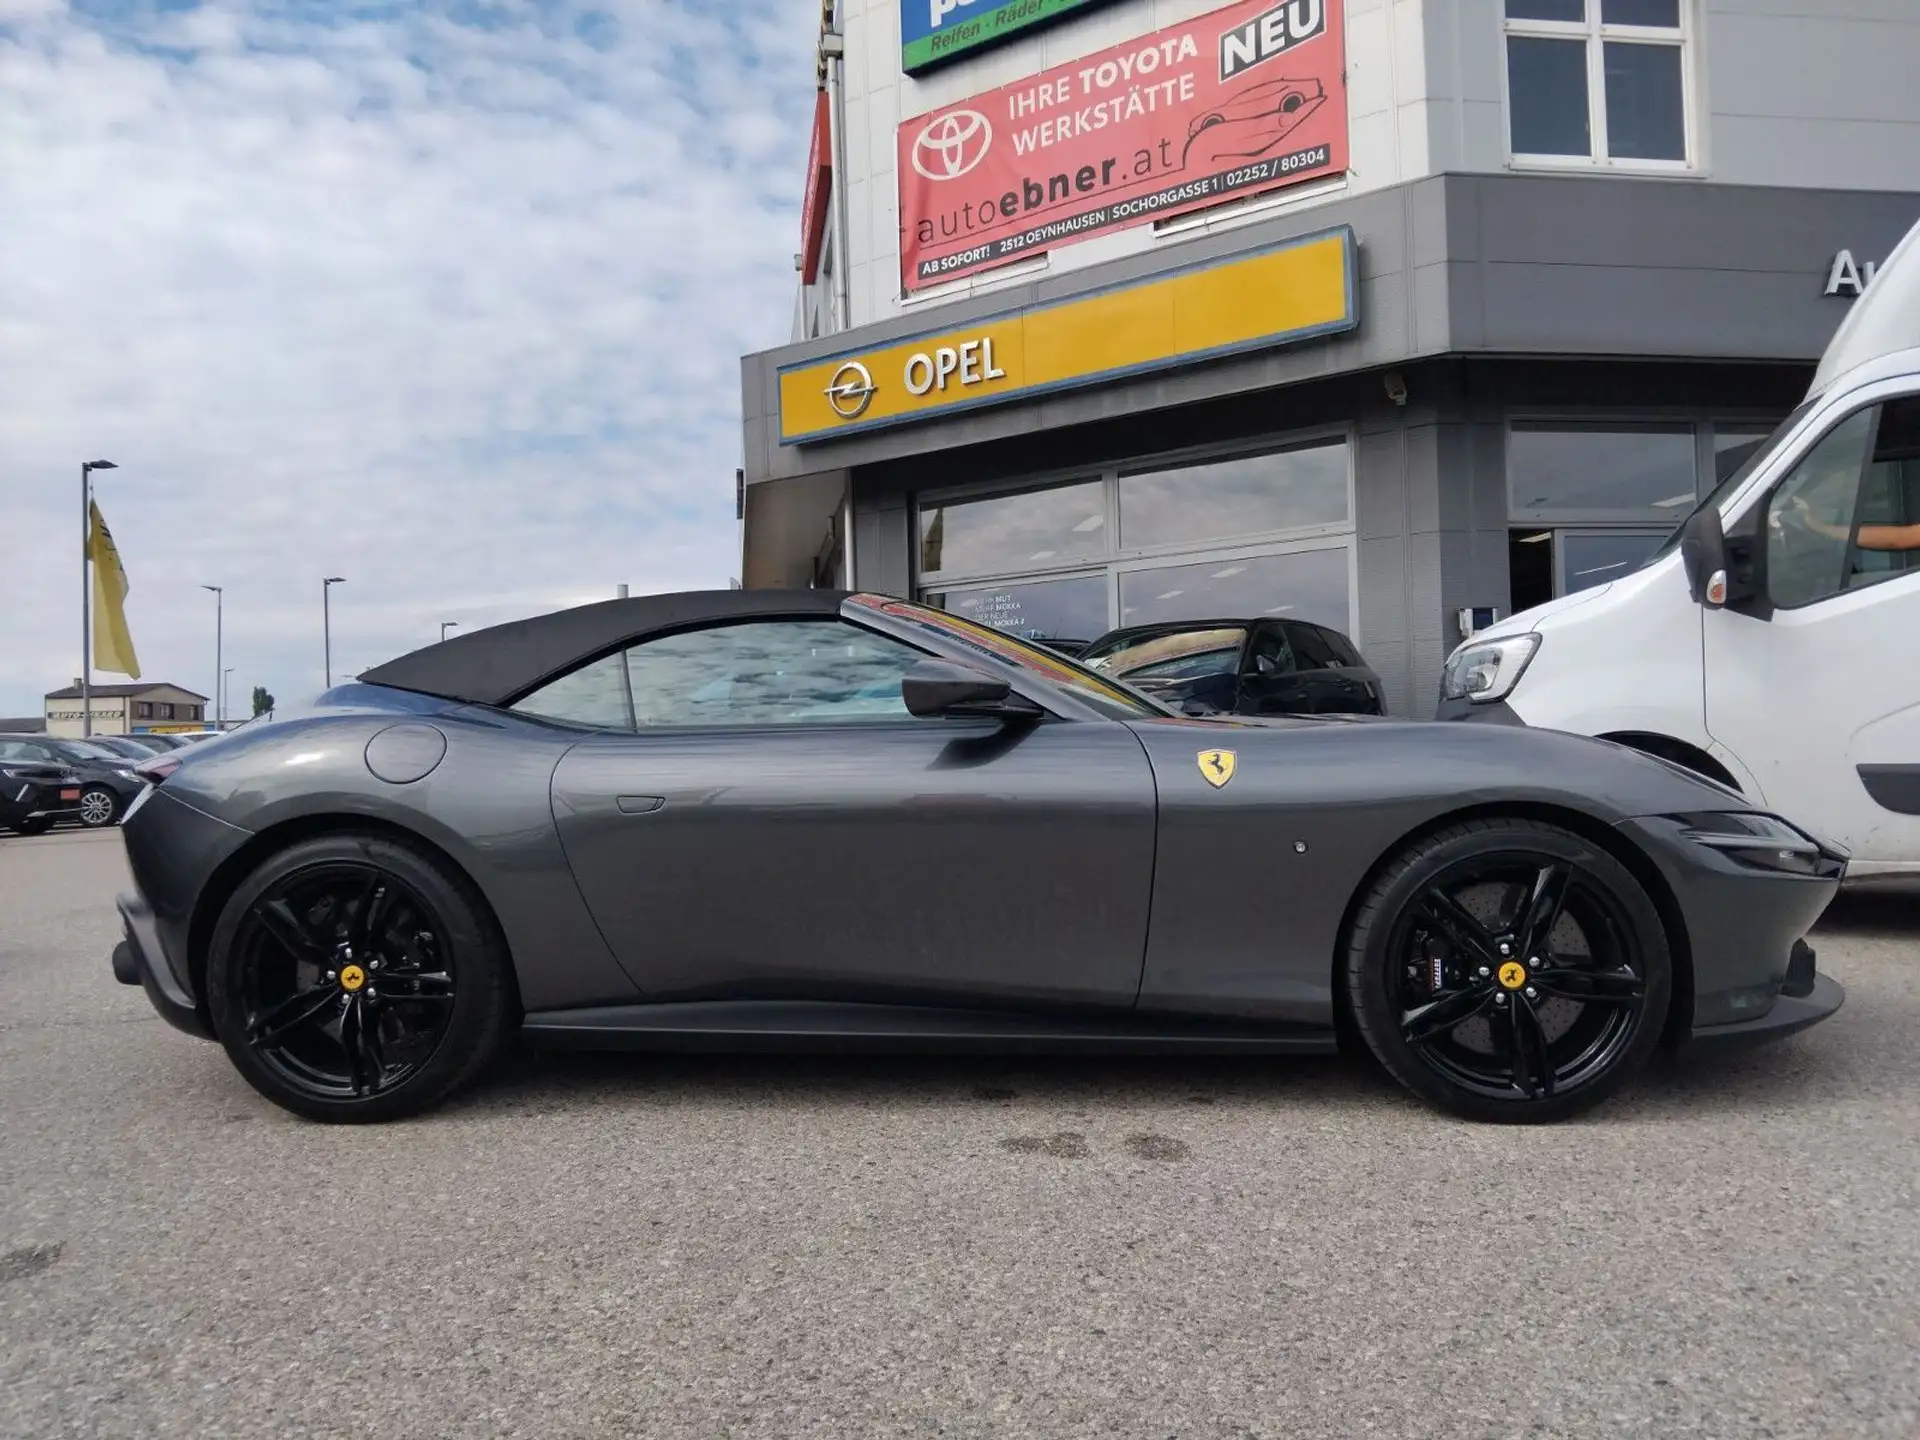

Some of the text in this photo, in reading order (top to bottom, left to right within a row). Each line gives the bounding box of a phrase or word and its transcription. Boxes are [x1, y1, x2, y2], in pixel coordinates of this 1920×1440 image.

[930, 0, 1044, 51] Reifen Räder
[1224, 0, 1320, 74] NEU
[1009, 34, 1198, 120] IHRE TOYOTA
[1012, 72, 1195, 156] WERKSTÄTTE
[918, 138, 1172, 243] autoebner.at
[922, 260, 939, 275] AB
[941, 245, 990, 270] SOFORT!
[1001, 235, 1025, 252] 2512
[1026, 211, 1105, 245] OEYNHAUSEN
[1112, 181, 1209, 219] SOCHORGASSE
[1212, 178, 1218, 191] 1
[1227, 164, 1268, 186] 02252
[1281, 148, 1325, 172] 80304
[904, 337, 1005, 396] OPEL
